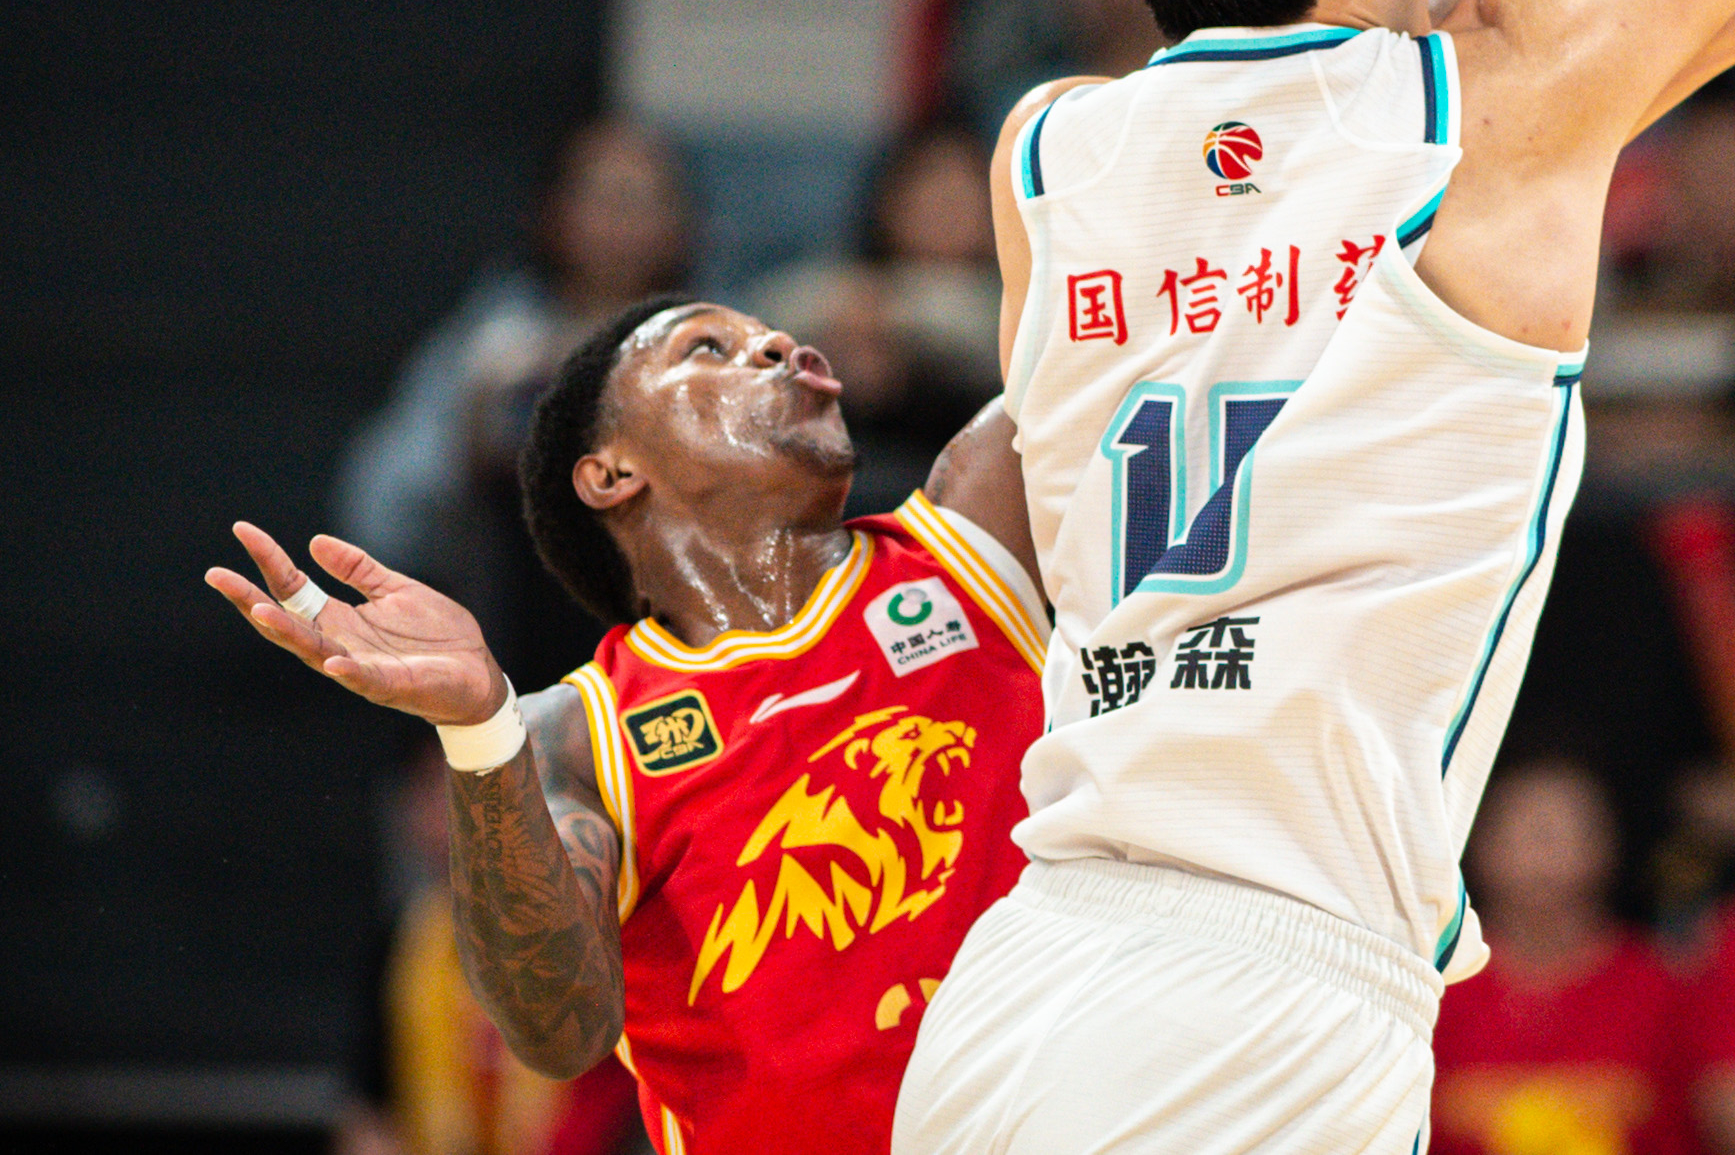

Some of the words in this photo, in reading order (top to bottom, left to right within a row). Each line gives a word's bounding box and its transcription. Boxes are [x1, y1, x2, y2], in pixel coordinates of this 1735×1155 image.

[1215, 182, 1262, 197] CBA
[890, 620, 962, 654] 中国人寿
[897, 645, 937, 665] CHINA
[939, 633, 967, 648] LIFE
